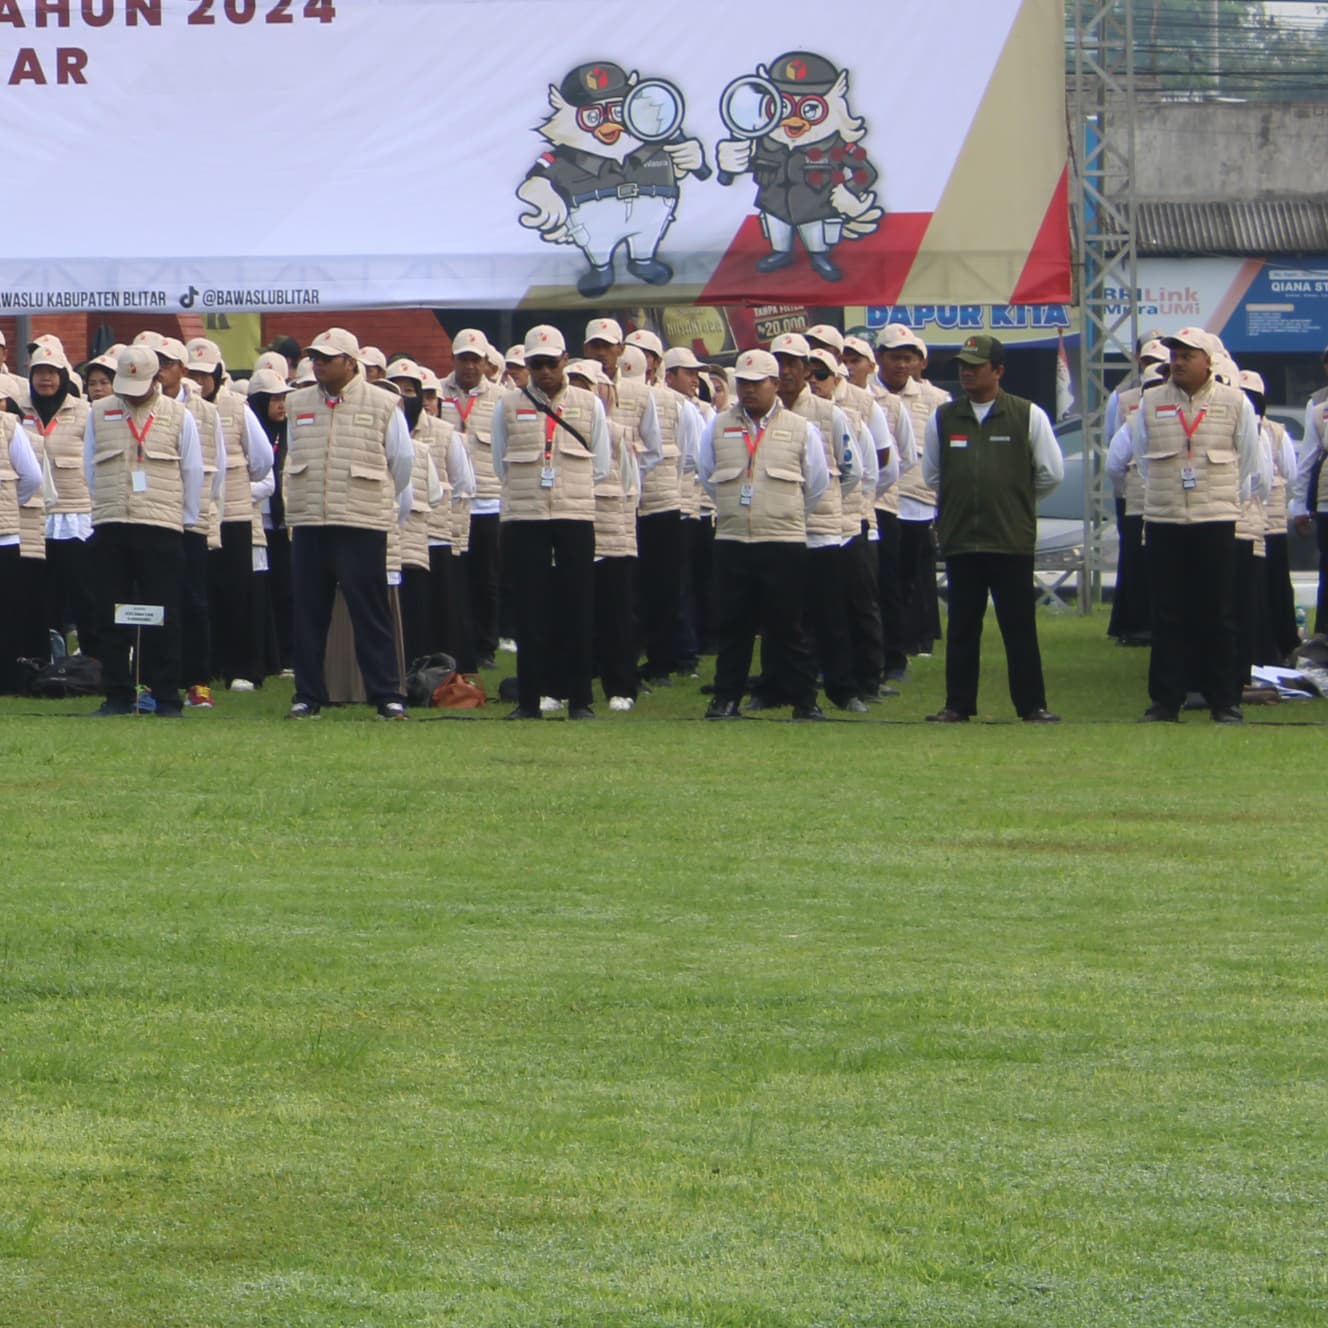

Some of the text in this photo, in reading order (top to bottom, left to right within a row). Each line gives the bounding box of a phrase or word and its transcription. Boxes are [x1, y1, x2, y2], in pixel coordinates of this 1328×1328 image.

[1271, 282, 1311, 292] QIANA
[47, 291, 120, 308] KABUPATEN
[123, 290, 166, 307] BLITAR
[203, 289, 319, 307] @BAWASLUBLITAR
[866, 304, 1071, 329] DAPUR KITA
